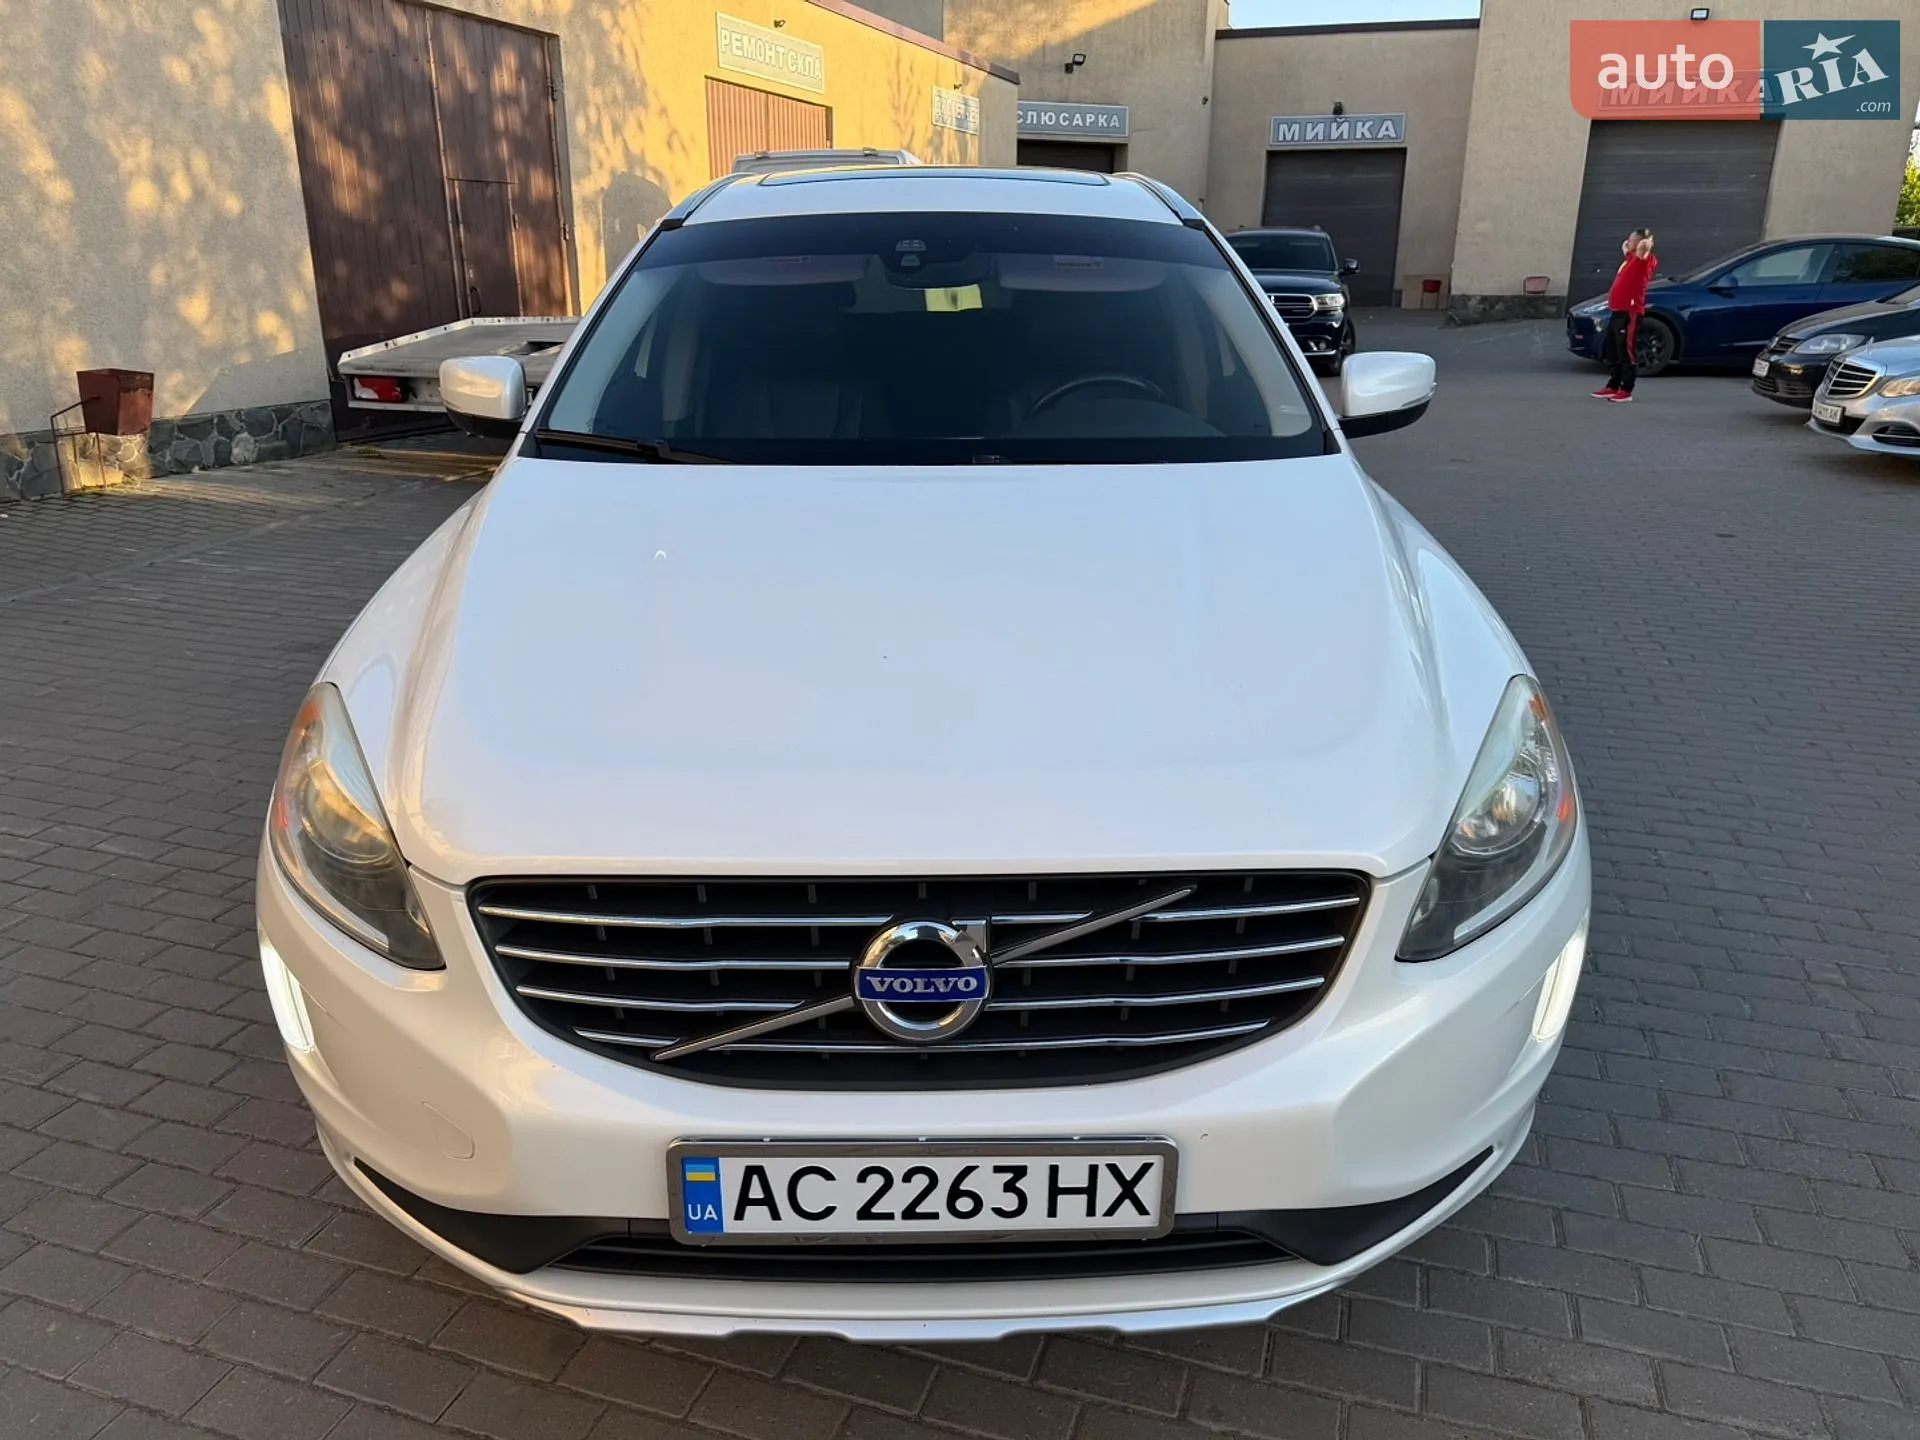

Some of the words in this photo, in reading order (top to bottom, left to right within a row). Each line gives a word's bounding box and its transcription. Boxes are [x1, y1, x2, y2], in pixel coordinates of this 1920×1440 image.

[720, 28, 786, 69] РЕМОНТ
[787, 49, 822, 80] СКЛА
[1278, 117, 1397, 141] МИЙКА
[866, 976, 978, 993] VOLVO
[733, 1164, 837, 1222] AC
[856, 1164, 1028, 1221] 2263
[1046, 1162, 1154, 1218] HX
[687, 1203, 718, 1221] UA
